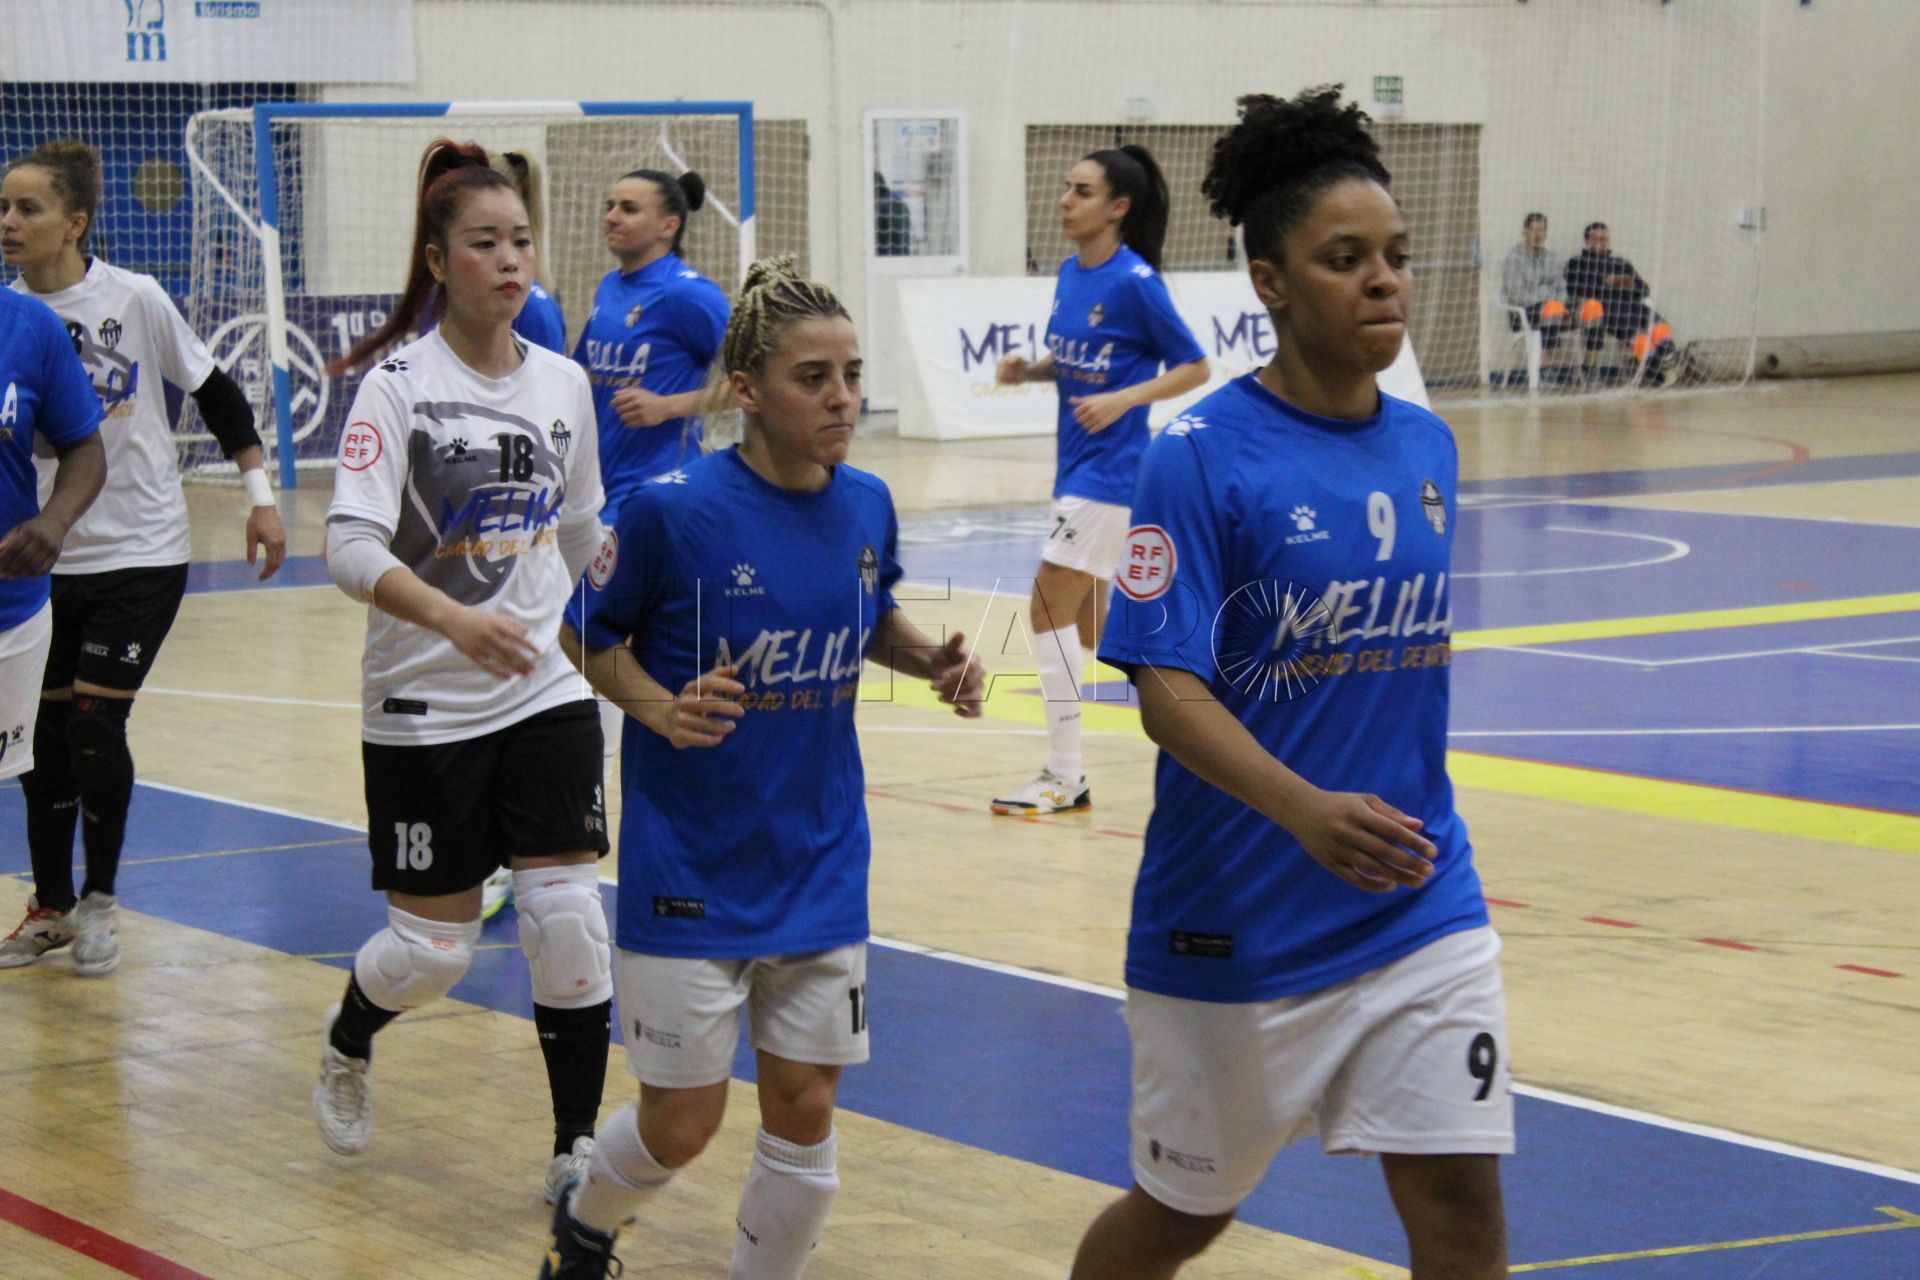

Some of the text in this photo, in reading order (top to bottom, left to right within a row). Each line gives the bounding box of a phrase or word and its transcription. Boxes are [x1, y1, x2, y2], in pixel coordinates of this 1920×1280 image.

[444, 455, 479, 465] KELME
[497, 434, 534, 483] 18
[1366, 491, 1396, 561] 9
[1285, 530, 1331, 545] KELME
[1131, 543, 1164, 561] RF
[1128, 564, 1162, 580] EF
[725, 586, 767, 597] KELME
[394, 821, 434, 871] 18
[1469, 1031, 1497, 1102] 9
